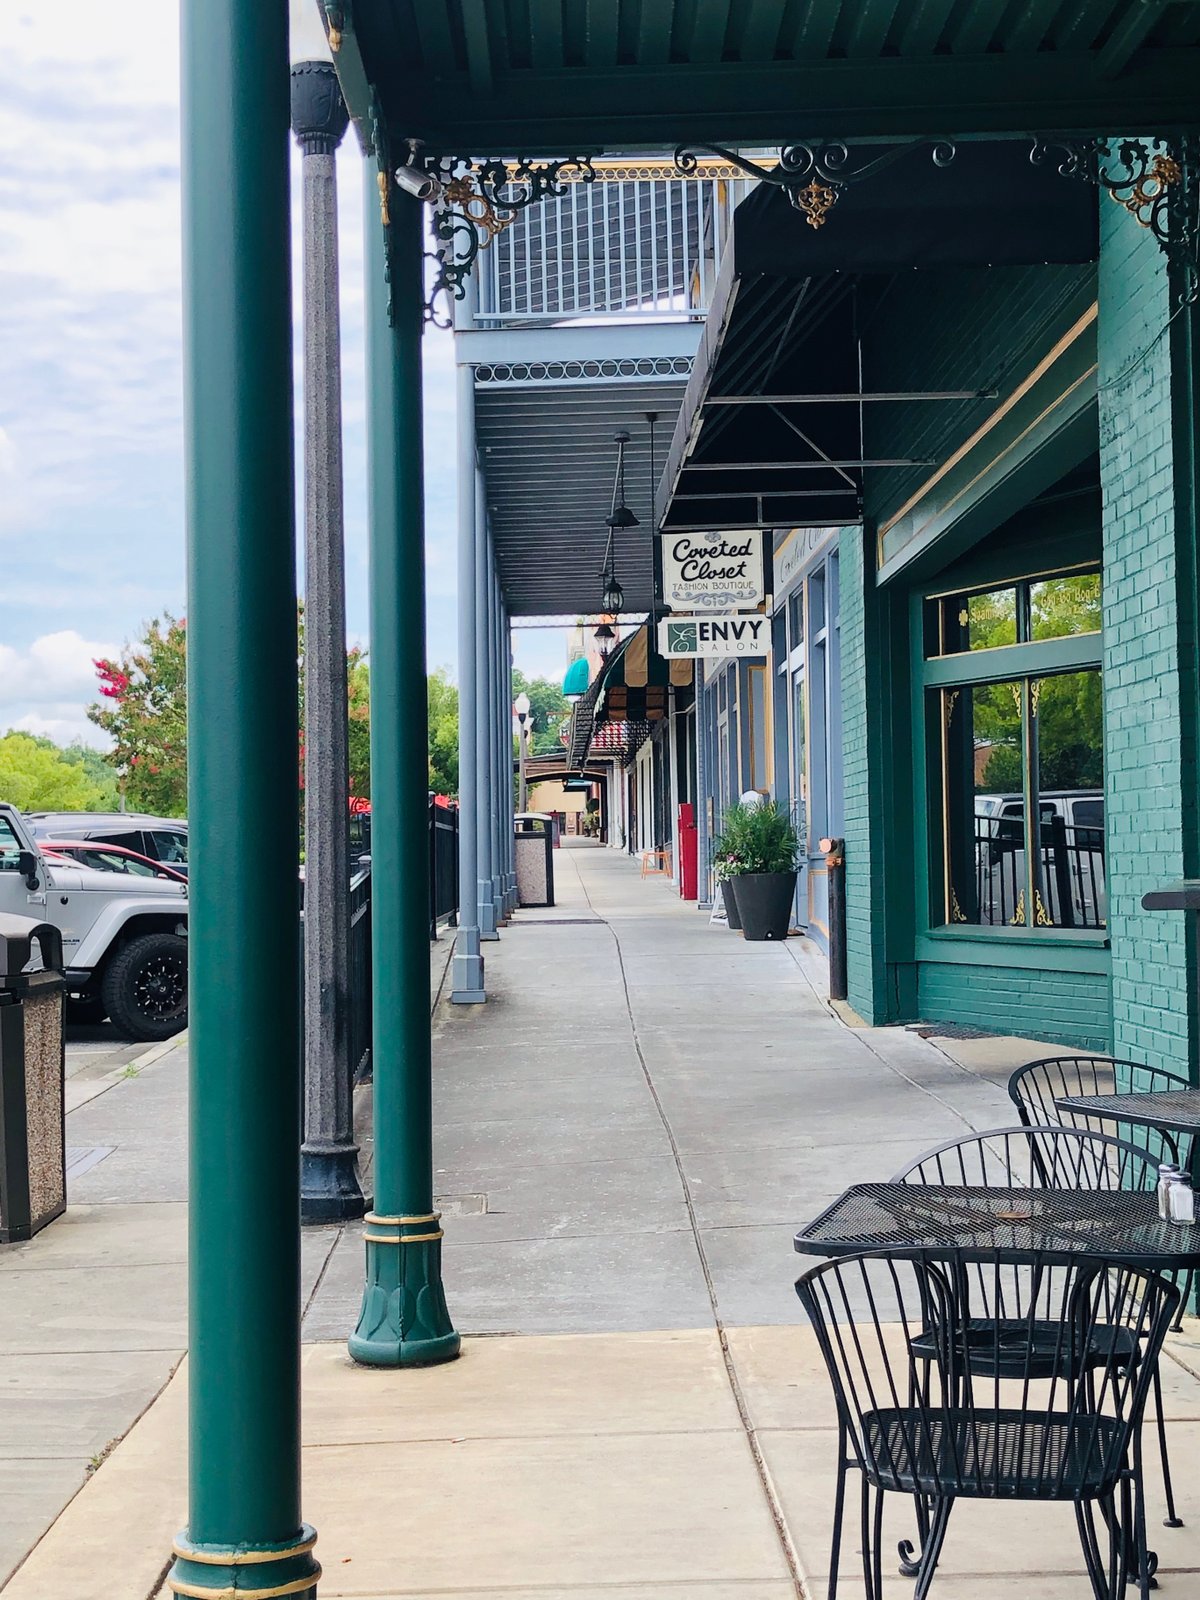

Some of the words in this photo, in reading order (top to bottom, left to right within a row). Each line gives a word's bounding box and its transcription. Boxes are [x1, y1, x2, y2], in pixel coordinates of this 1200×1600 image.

[672, 537, 753, 562] Coveted
[680, 559, 747, 582] Closet
[712, 581, 754, 590] BOUTIQUE
[699, 620, 763, 641] ENVY
[699, 642, 758, 652] SALON
